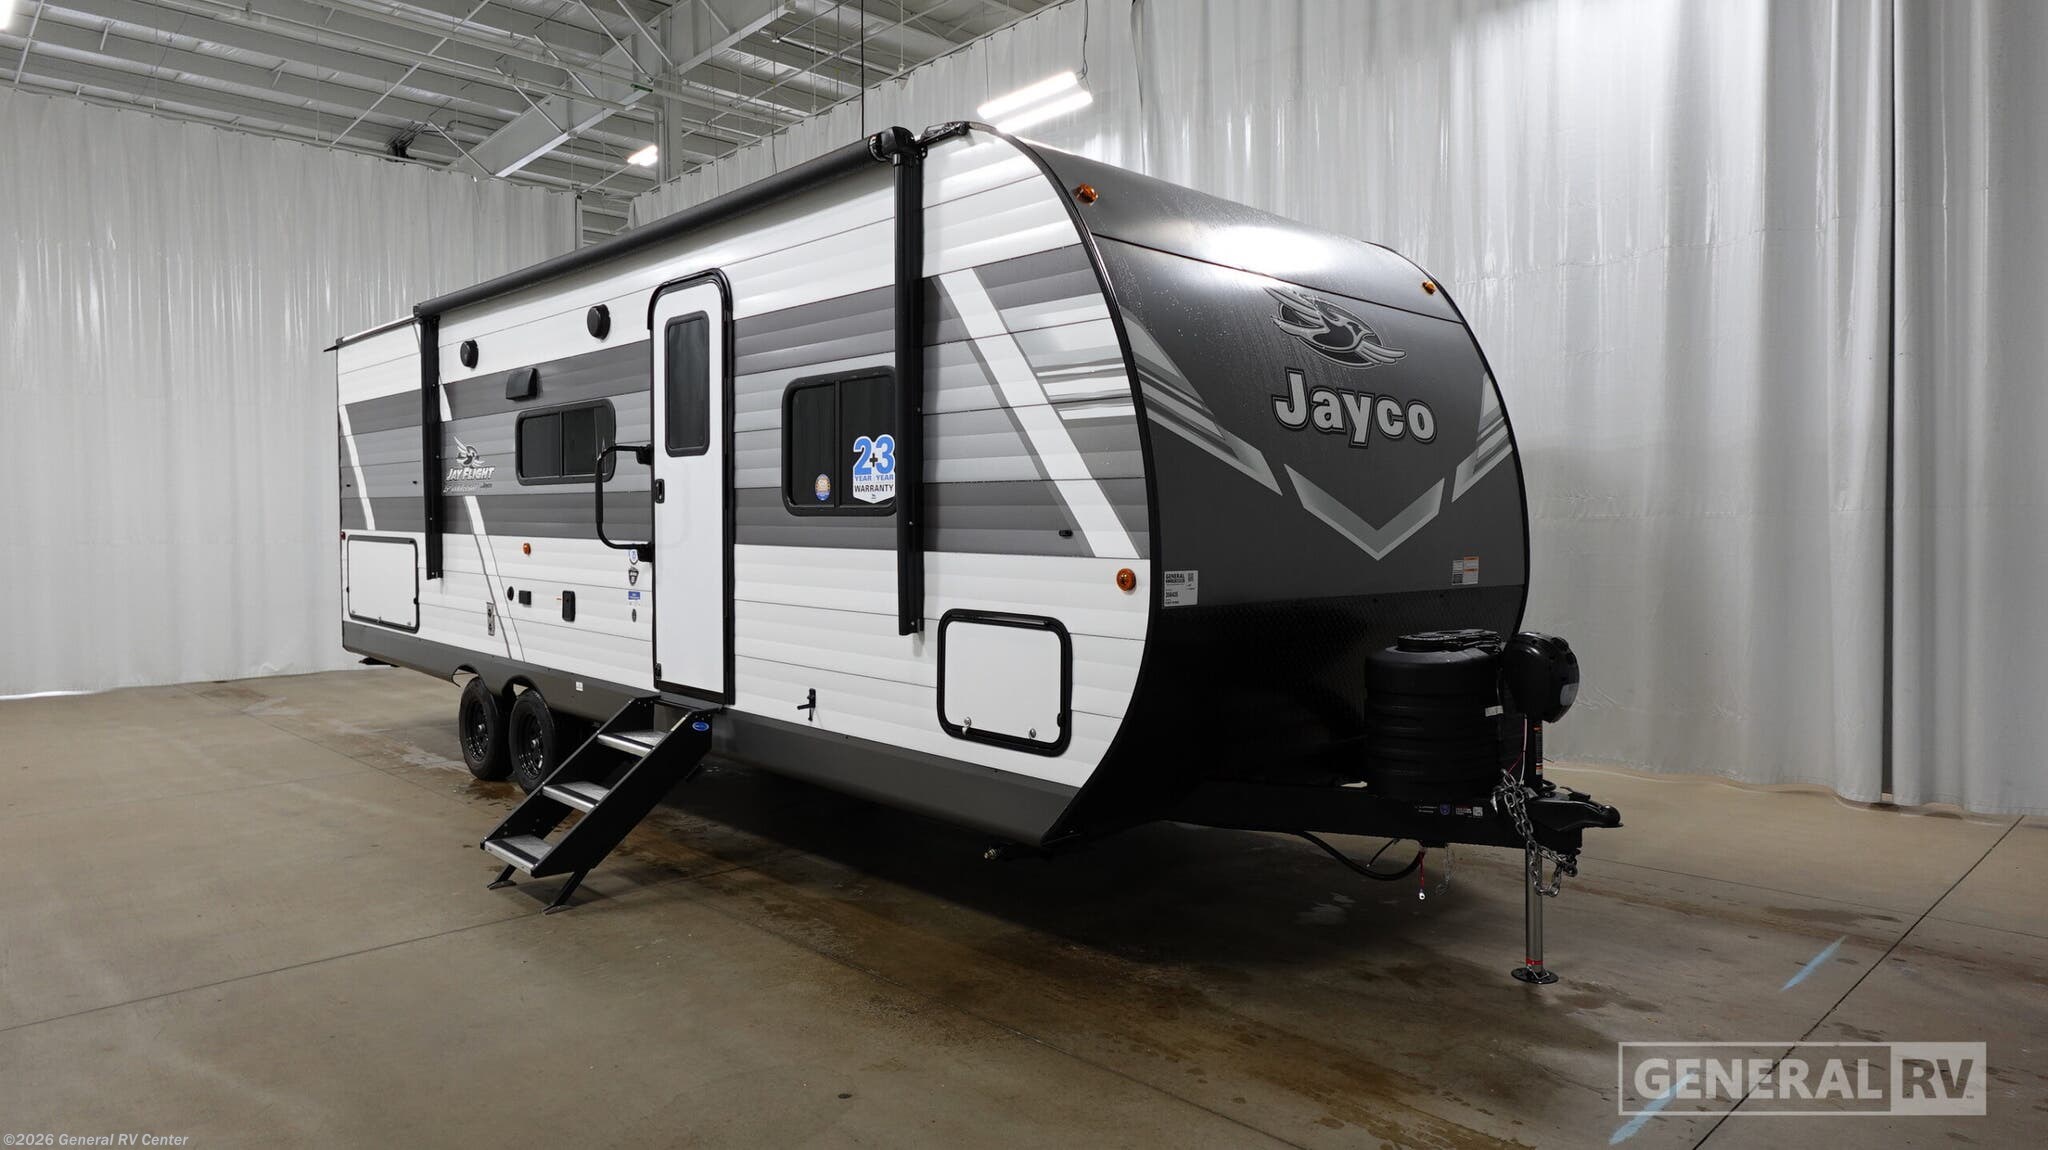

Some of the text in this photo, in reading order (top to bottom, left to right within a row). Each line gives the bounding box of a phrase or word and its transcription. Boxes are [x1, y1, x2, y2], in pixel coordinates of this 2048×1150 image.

[1272, 367, 1437, 449] Jayco
[446, 467, 495, 481] JAY FLIGHT
[854, 484, 894, 493] WARRANTY
